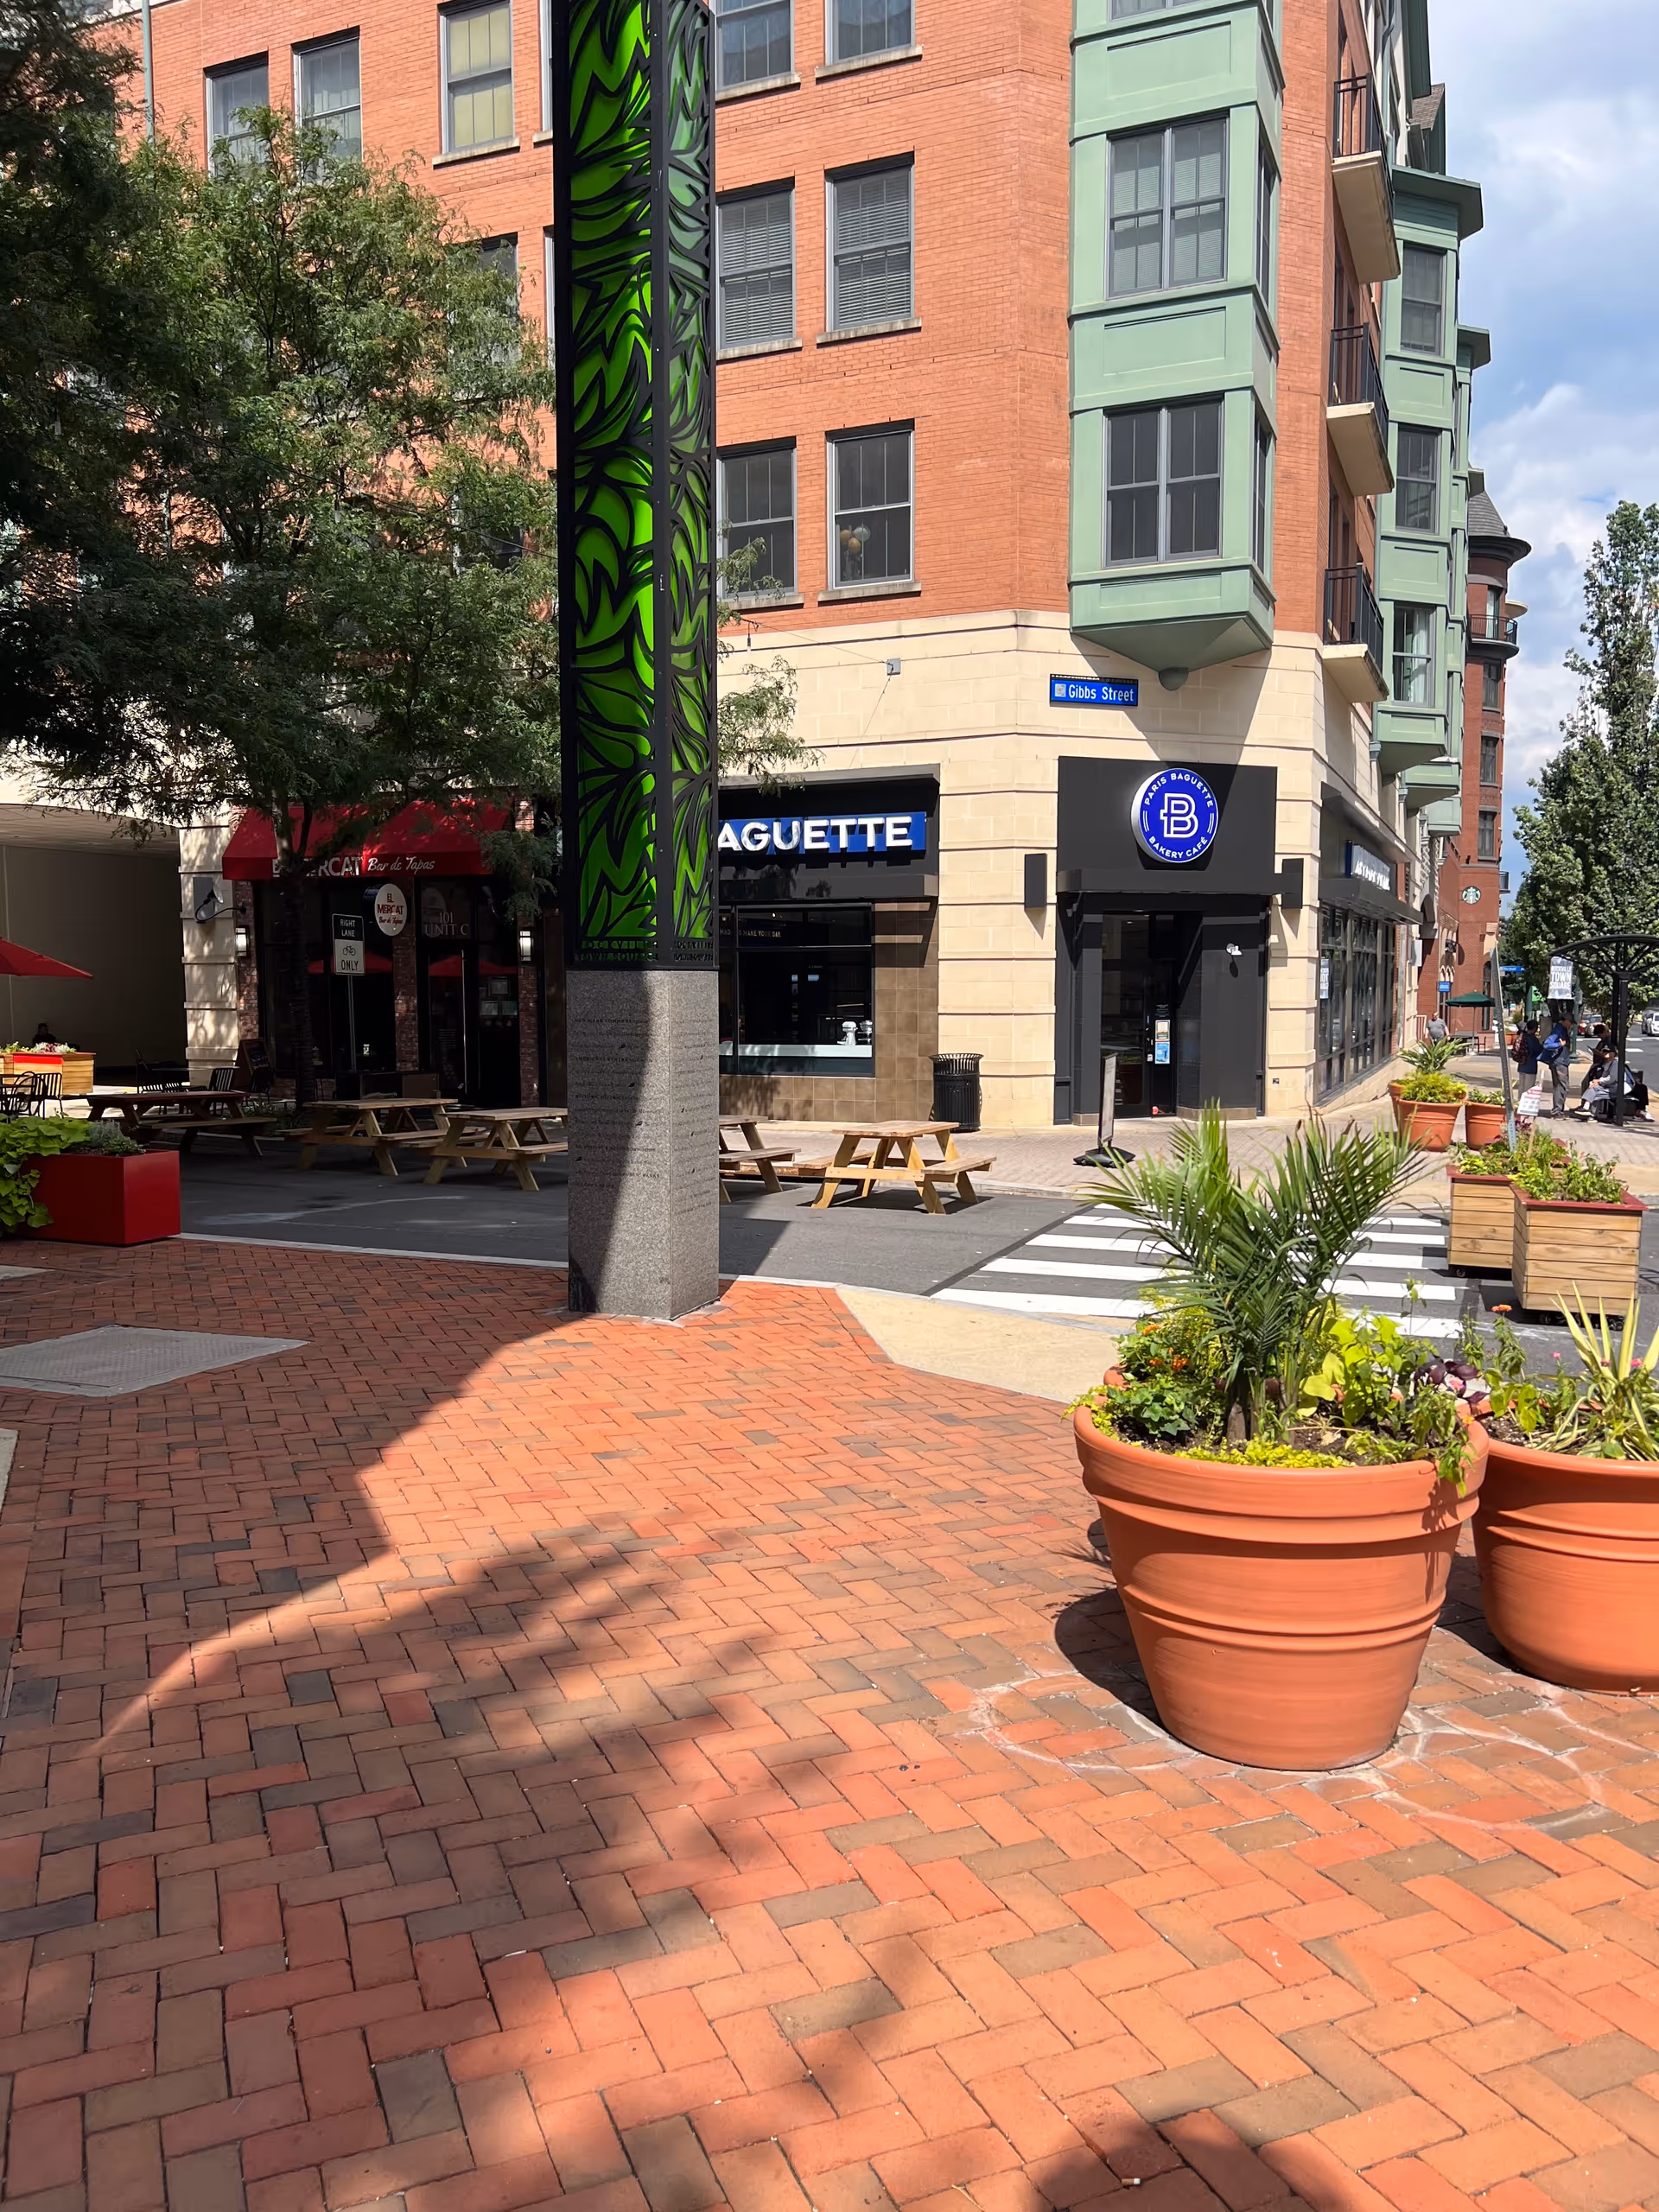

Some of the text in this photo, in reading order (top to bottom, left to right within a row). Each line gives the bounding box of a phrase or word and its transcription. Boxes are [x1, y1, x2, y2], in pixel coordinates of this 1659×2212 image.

[1068, 683, 1135, 702] Gibbs Street
[1144, 772, 1214, 808] PARIS BAGUETTE
[718, 816, 913, 852] AGUETTE
[1148, 836, 1208, 859] BAKERY CAFÉ
[302, 856, 362, 877] RCAT
[367, 857, 389, 871] Bar
[390, 856, 402, 871] de
[405, 855, 435, 875] Tapas
[386, 893, 395, 903] EL
[377, 903, 404, 915] MERCAT
[340, 918, 355, 927] RIGHT
[439, 912, 454, 924] 101
[341, 929, 355, 938] LANE
[424, 923, 470, 936] UNIT C
[340, 959, 359, 971] ONLY
[1551, 971, 1572, 982] TOWN
